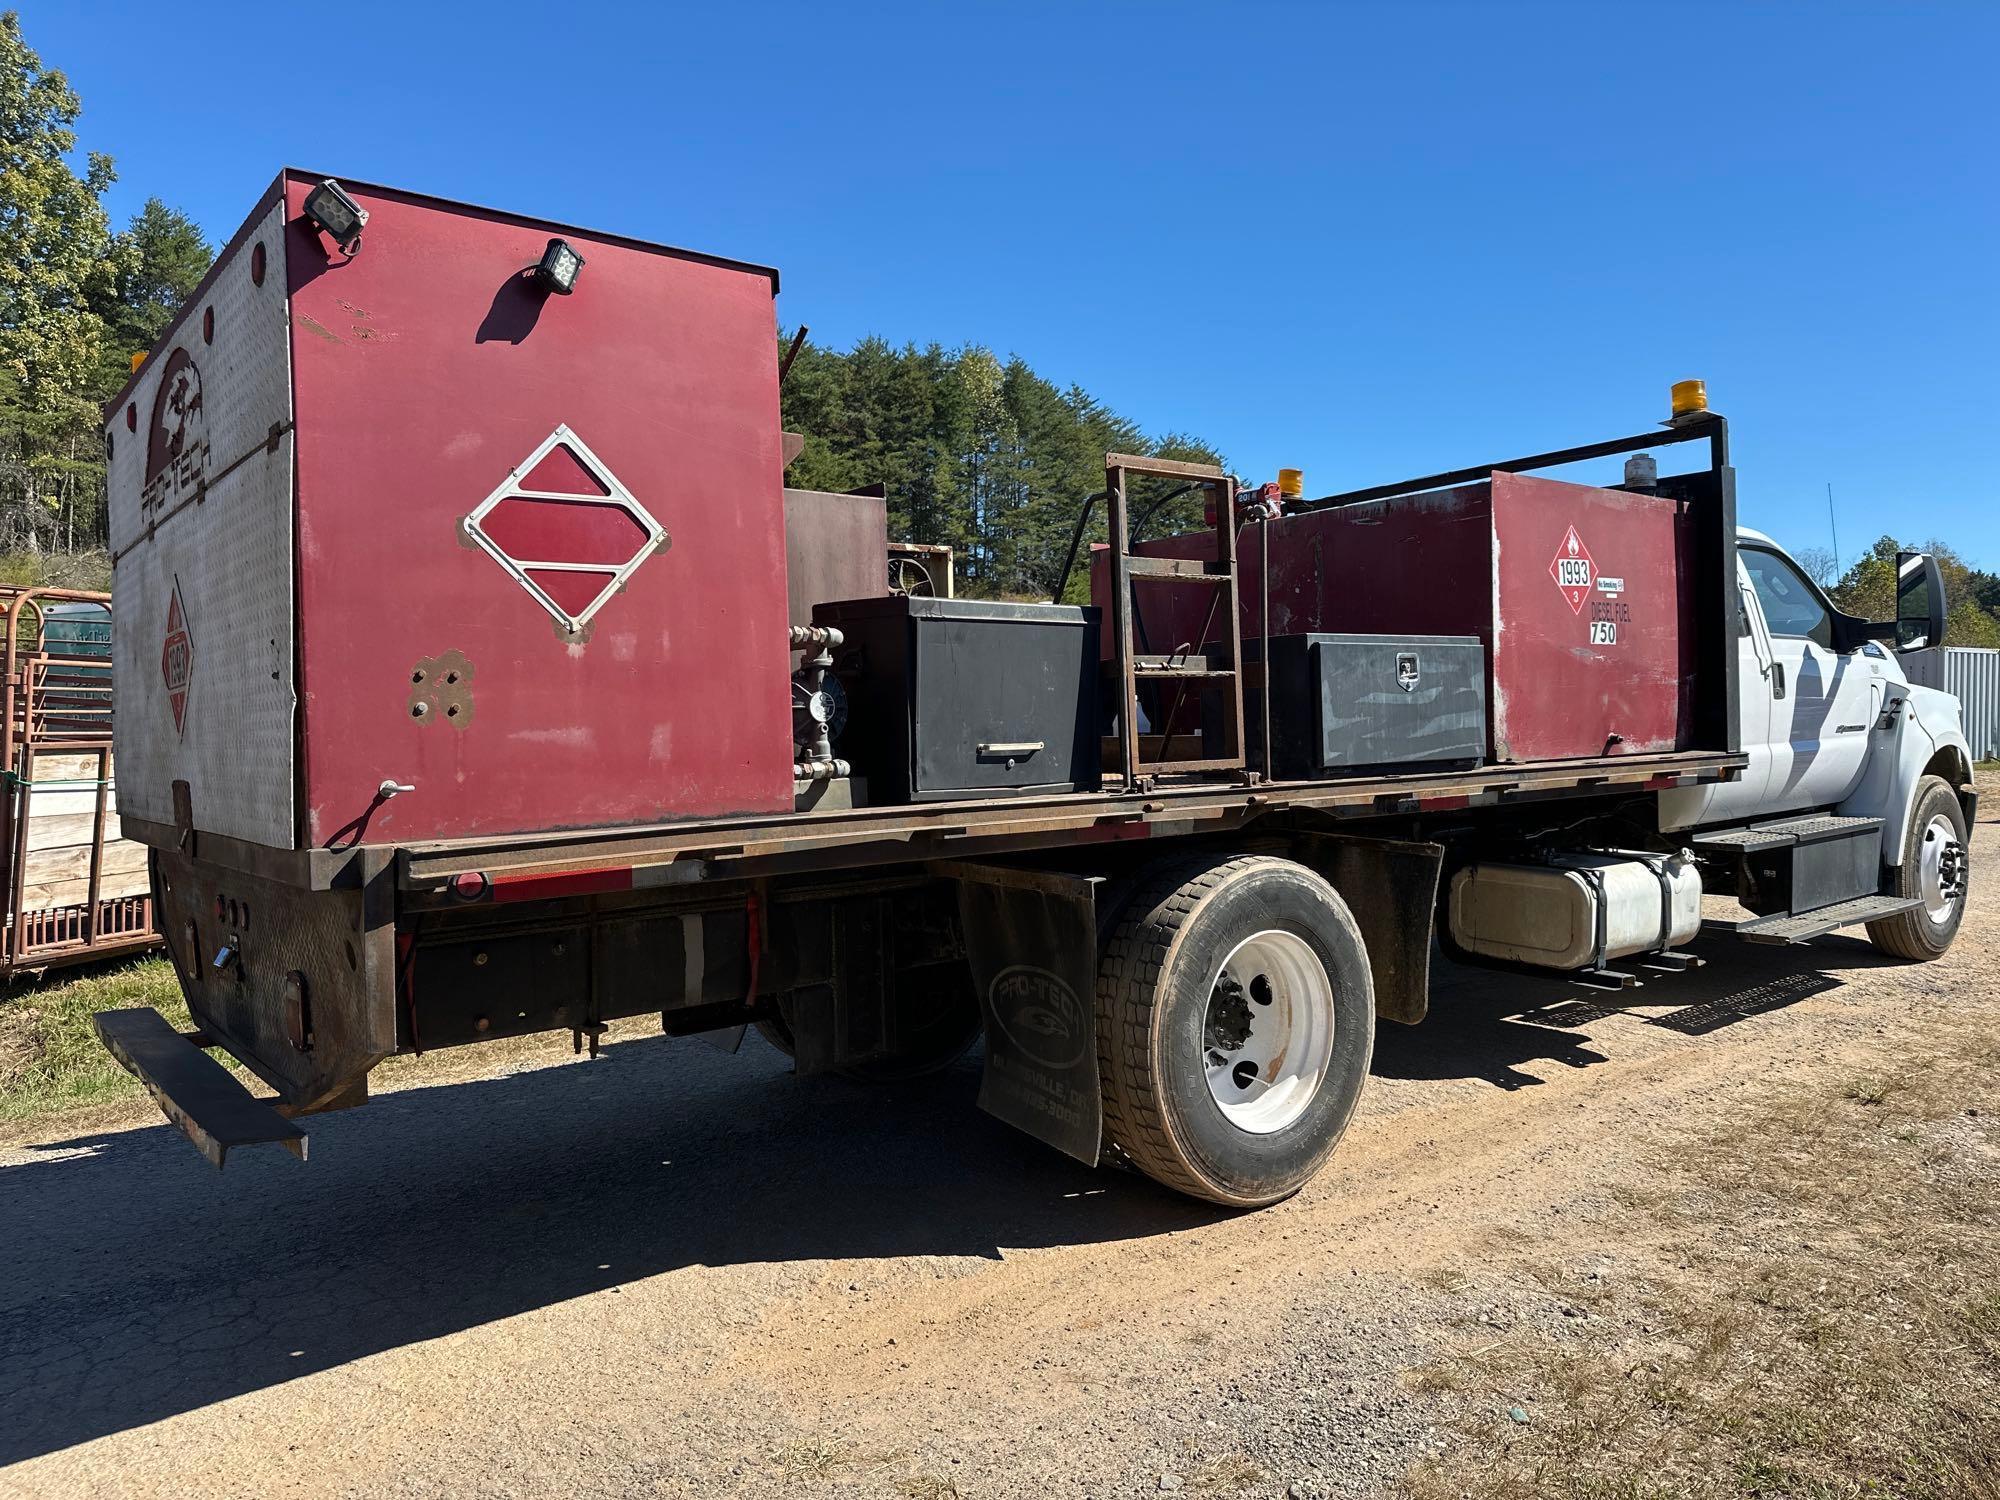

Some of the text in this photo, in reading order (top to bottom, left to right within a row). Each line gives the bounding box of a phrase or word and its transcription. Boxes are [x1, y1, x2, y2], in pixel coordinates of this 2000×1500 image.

[141, 439, 212, 525] PRO-TECH
[1560, 560, 1589, 585] 1993
[1603, 580, 1618, 591] Smoking
[1573, 590, 1580, 603] 3
[1591, 601, 1632, 623] DIESEL FUEL
[1591, 623, 1616, 644] 750
